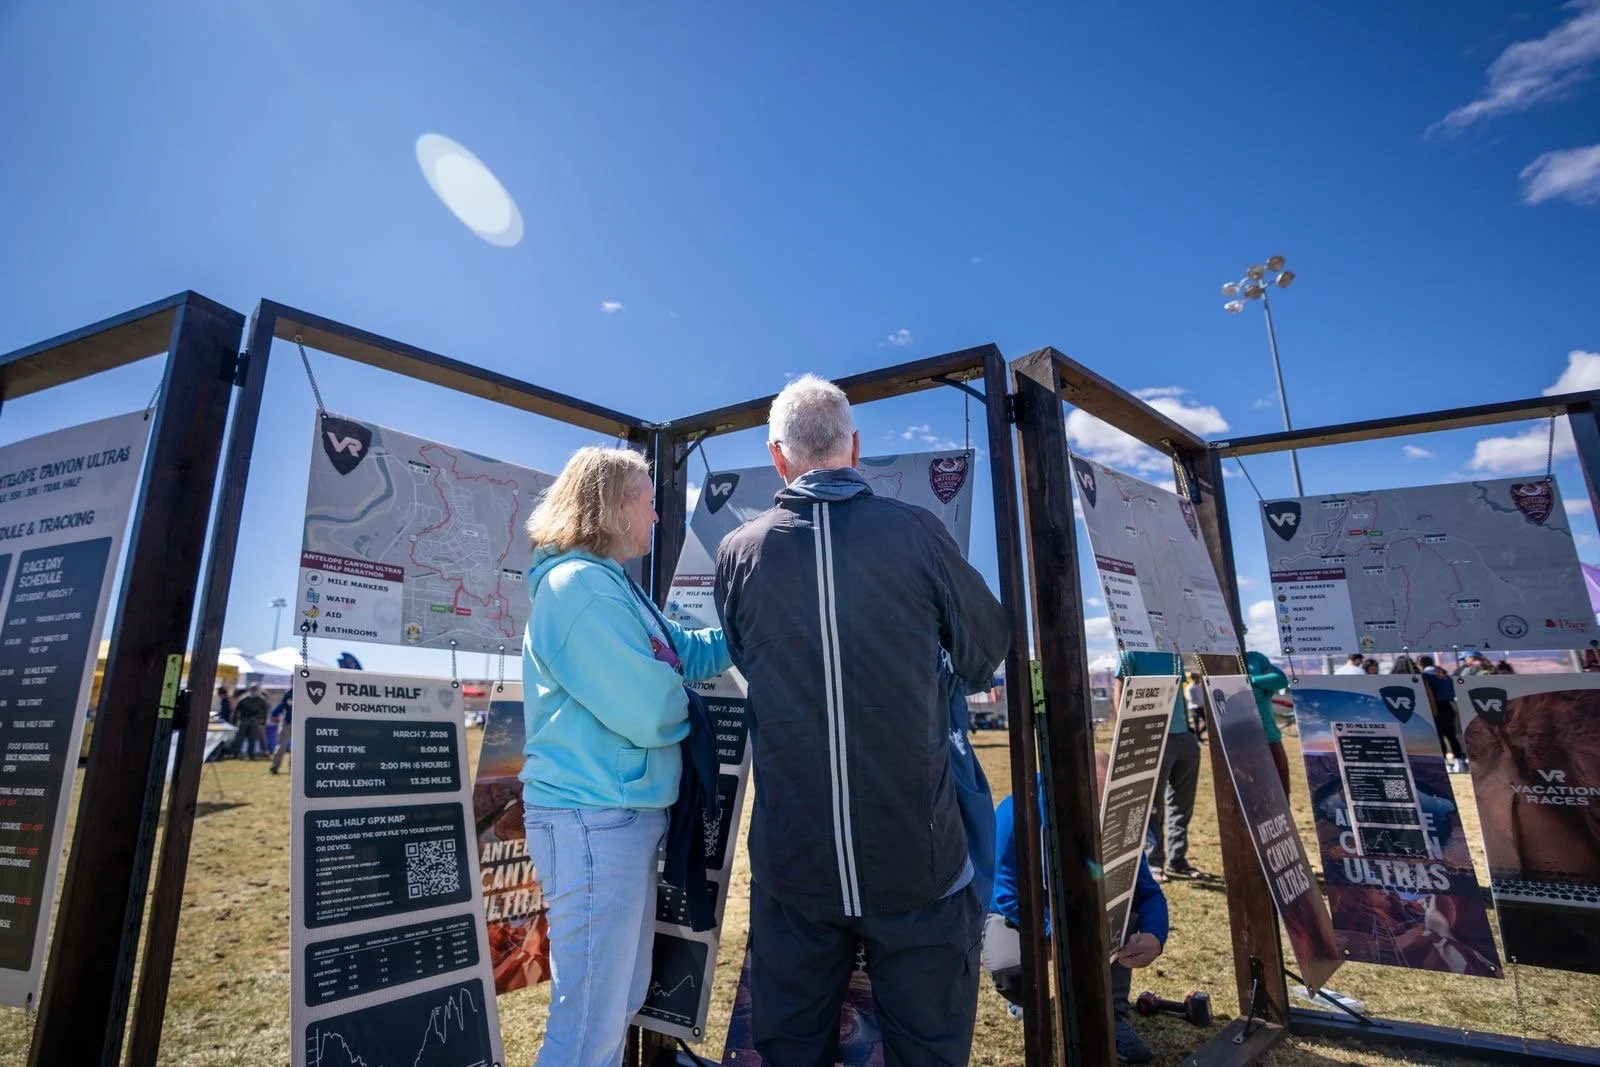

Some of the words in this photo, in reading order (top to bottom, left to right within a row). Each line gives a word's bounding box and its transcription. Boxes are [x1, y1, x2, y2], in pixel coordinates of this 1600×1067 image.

[327, 431, 363, 458] VR
[87, 446, 131, 469] ULTRAS
[63, 477, 82, 488] HALF
[1077, 470, 1094, 491] VR
[710, 481, 732, 497] VR
[26, 521, 34, 536] &
[39, 510, 95, 534] TRACKING
[1269, 511, 1297, 528] VR
[22, 558, 45, 574] RACE
[47, 556, 64, 570] DAY
[303, 553, 342, 565] ANTELOPE
[344, 560, 374, 570] CANYON
[375, 566, 402, 575] ULTRAS
[323, 563, 343, 571] HALF
[344, 566, 384, 578] MARATHON
[19, 571, 63, 588] SCHEDULE
[328, 578, 348, 587] MILE
[350, 581, 389, 592] MARKERS
[326, 595, 356, 605] WATER
[325, 611, 342, 619] AID
[325, 626, 378, 637] BATHROOMS
[309, 687, 324, 697] VR
[336, 682, 382, 698] TRAIL
[385, 686, 421, 700] HALF
[1146, 688, 1160, 698] RACE
[335, 702, 406, 714] INFORMATION
[1384, 696, 1412, 710] VR
[1475, 699, 1502, 712] VR
[316, 728, 339, 737] DATE
[393, 730, 420, 738] MARCH
[316, 745, 346, 753] START
[347, 746, 366, 754] TIME
[316, 762, 356, 770] CUT-OFF
[380, 762, 398, 770] 2:00
[316, 779, 351, 788] ACTUAL
[352, 779, 385, 787] LENGTH
[431, 776, 451, 784] MILES
[1536, 769, 1566, 783] VR
[25, 788, 45, 796] COURSE
[1511, 785, 1600, 796] VACATION
[1527, 796, 1590, 806] RACES
[1, 823, 21, 831] COURSE
[315, 819, 342, 829] TRAIL
[343, 818, 366, 827] HALF
[368, 816, 386, 825] GPX
[1257, 813, 1290, 845] ANTELOPE
[326, 833, 361, 841] DOWNLOAD
[425, 825, 454, 833] COMPUTER
[480, 838, 529, 863] ANTEL
[1266, 837, 1300, 873] CANYON
[481, 860, 537, 893] CANY
[1343, 857, 1450, 892] ULTRAS
[1275, 864, 1310, 905] ULTRAS
